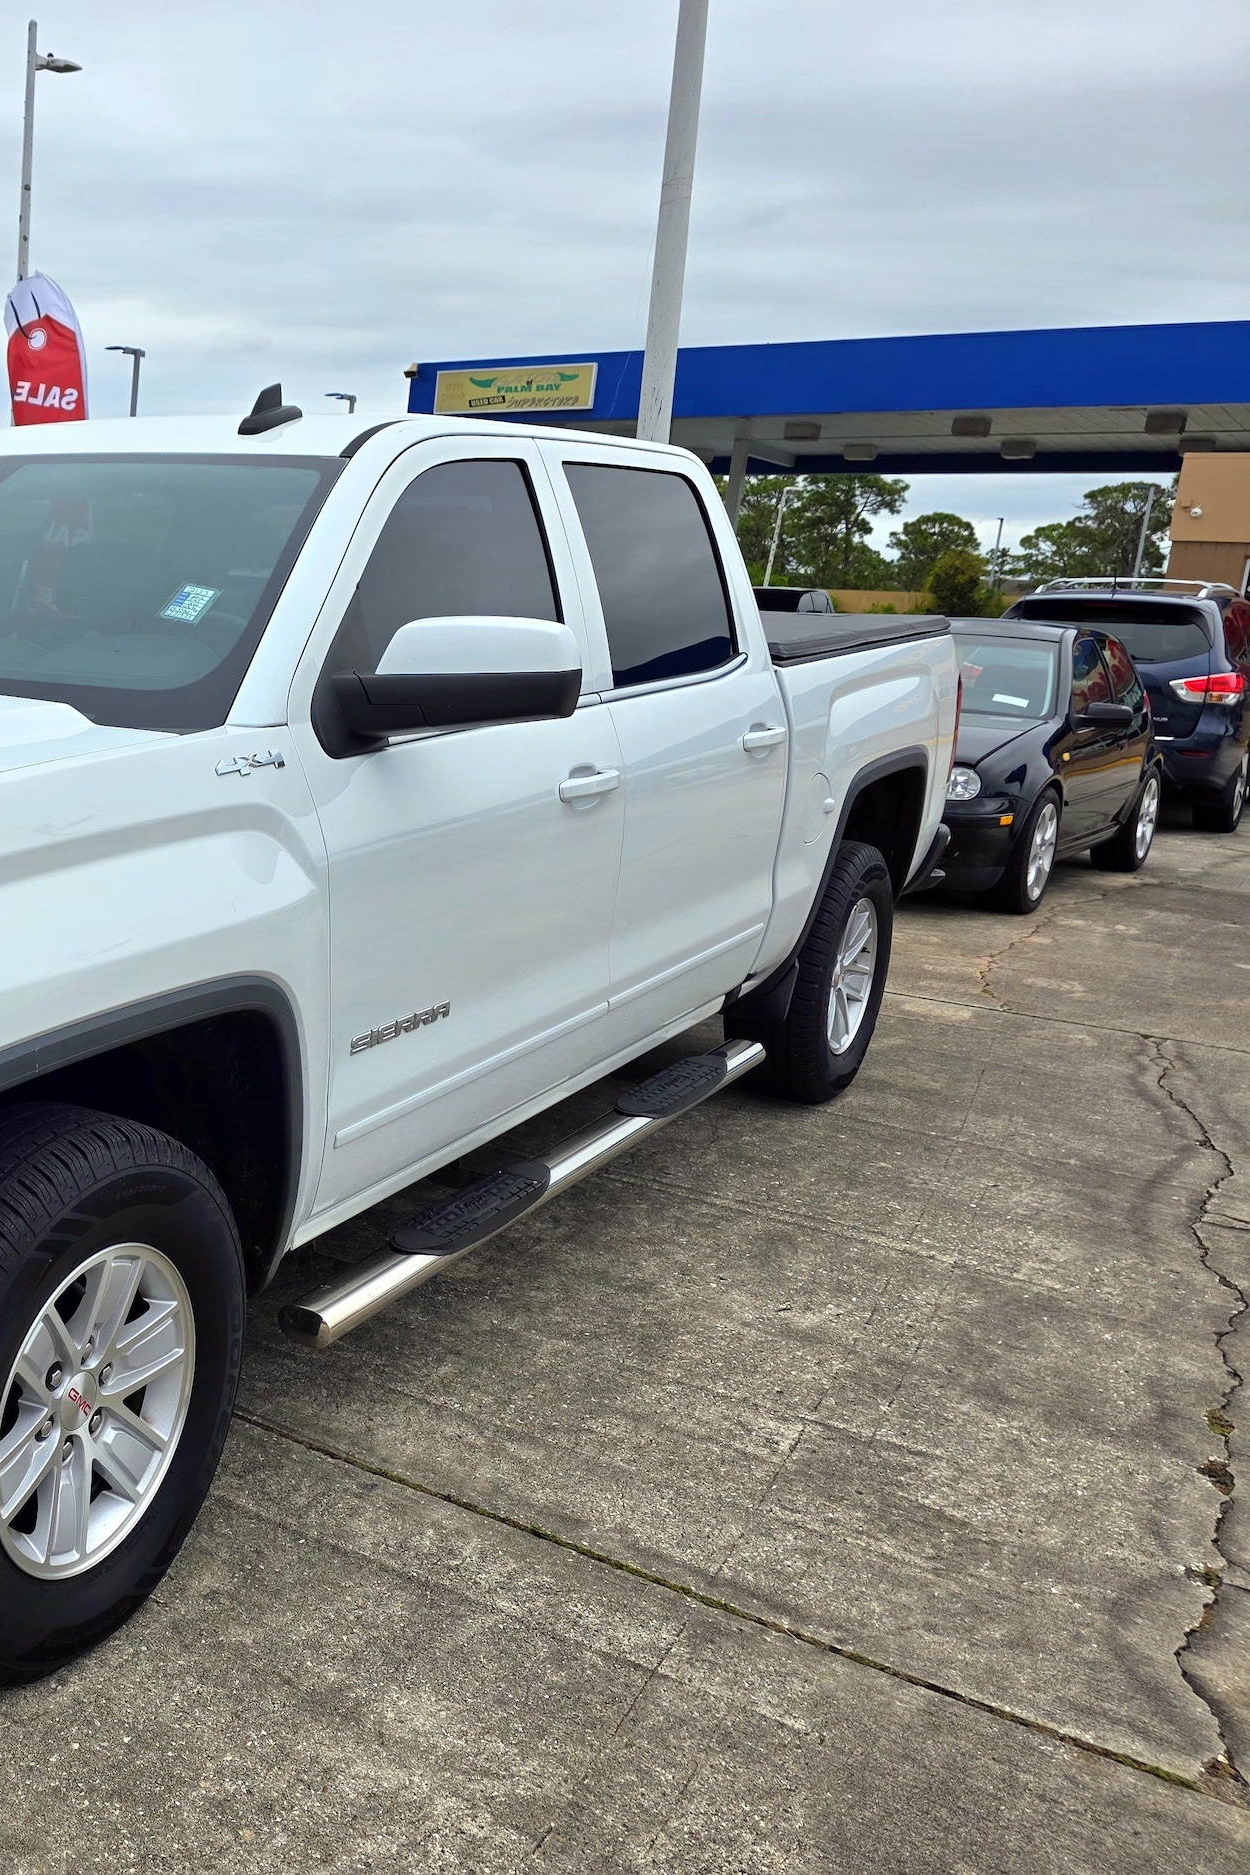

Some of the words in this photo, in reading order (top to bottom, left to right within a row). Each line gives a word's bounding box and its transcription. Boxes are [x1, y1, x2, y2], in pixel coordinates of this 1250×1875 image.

[496, 384, 532, 394] PALM
[535, 383, 563, 393] BAY
[470, 397, 488, 407] USED
[489, 395, 505, 405] CAR
[349, 999, 451, 1056] SIERRA
[67, 1387, 92, 1417] GMC
